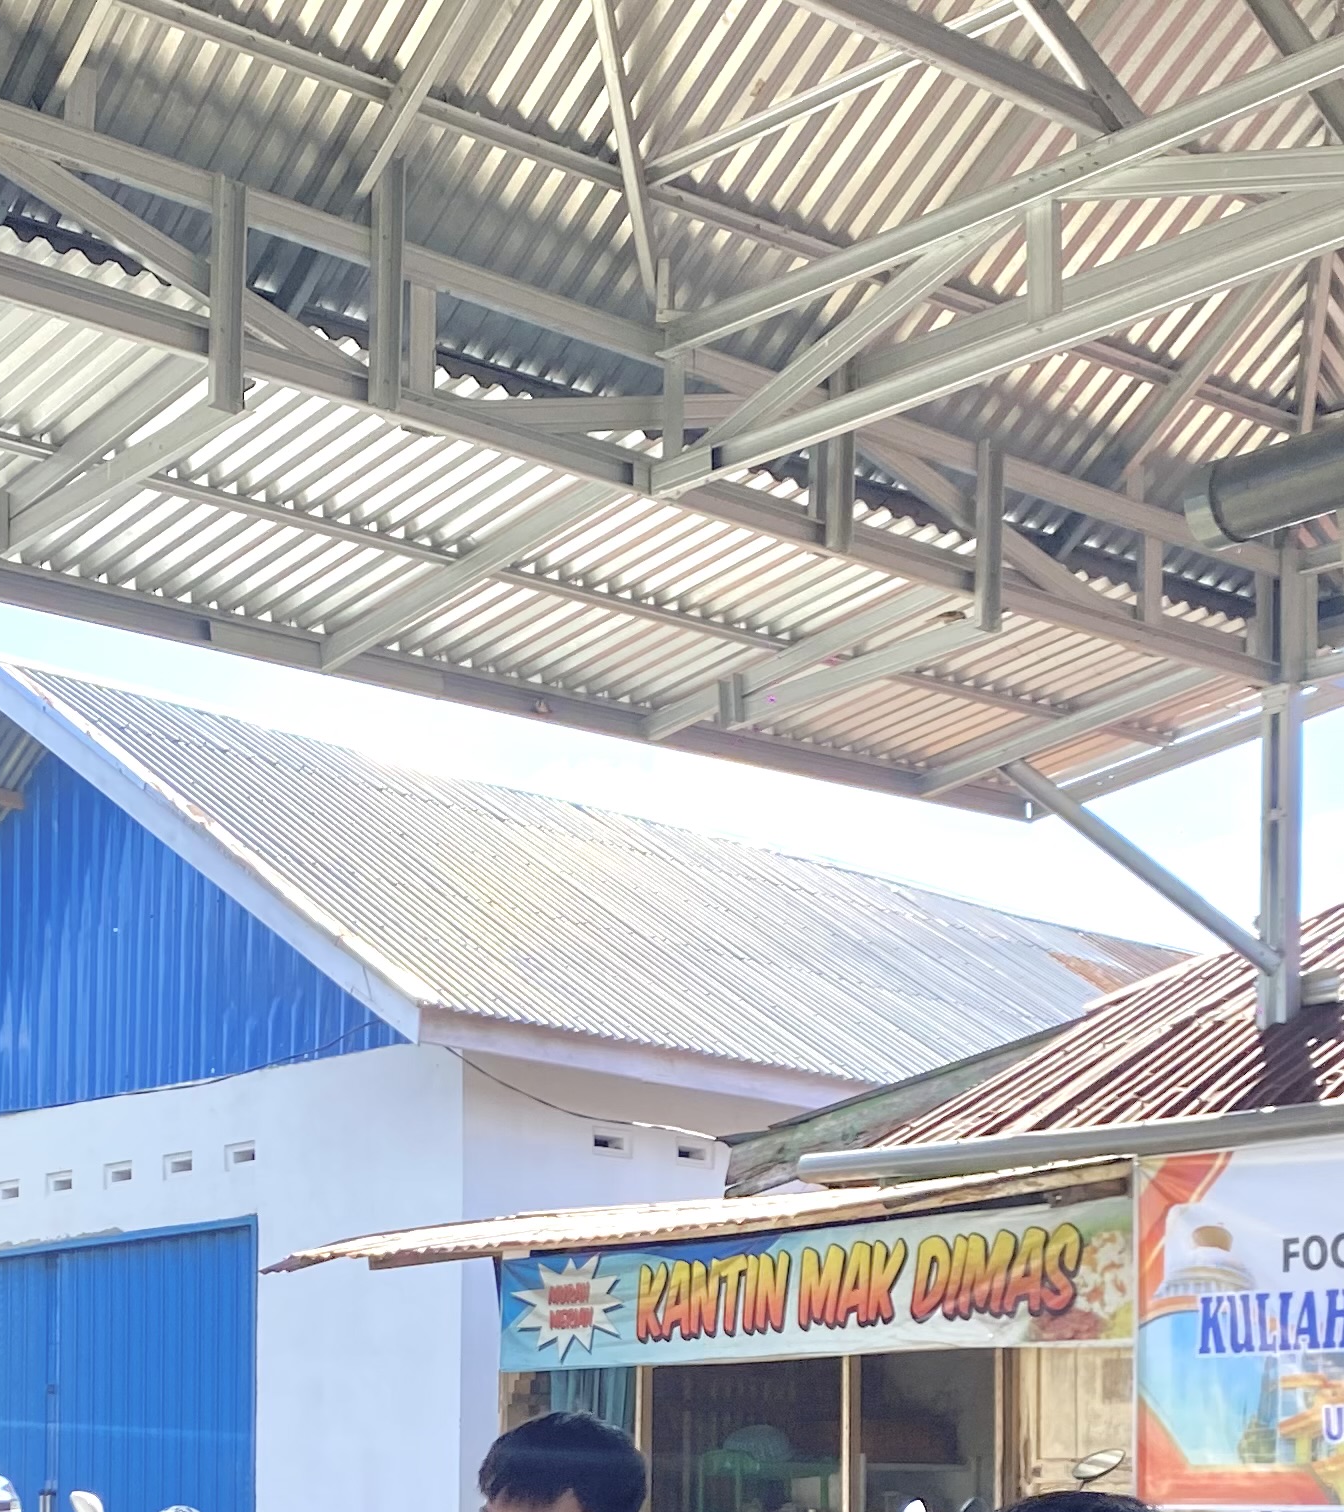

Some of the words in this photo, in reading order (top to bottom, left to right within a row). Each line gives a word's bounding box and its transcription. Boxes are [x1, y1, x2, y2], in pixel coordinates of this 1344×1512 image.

[636, 1249, 791, 1344] KANTIN
[797, 1238, 907, 1332] MAK
[910, 1223, 1084, 1324] DIMAS
